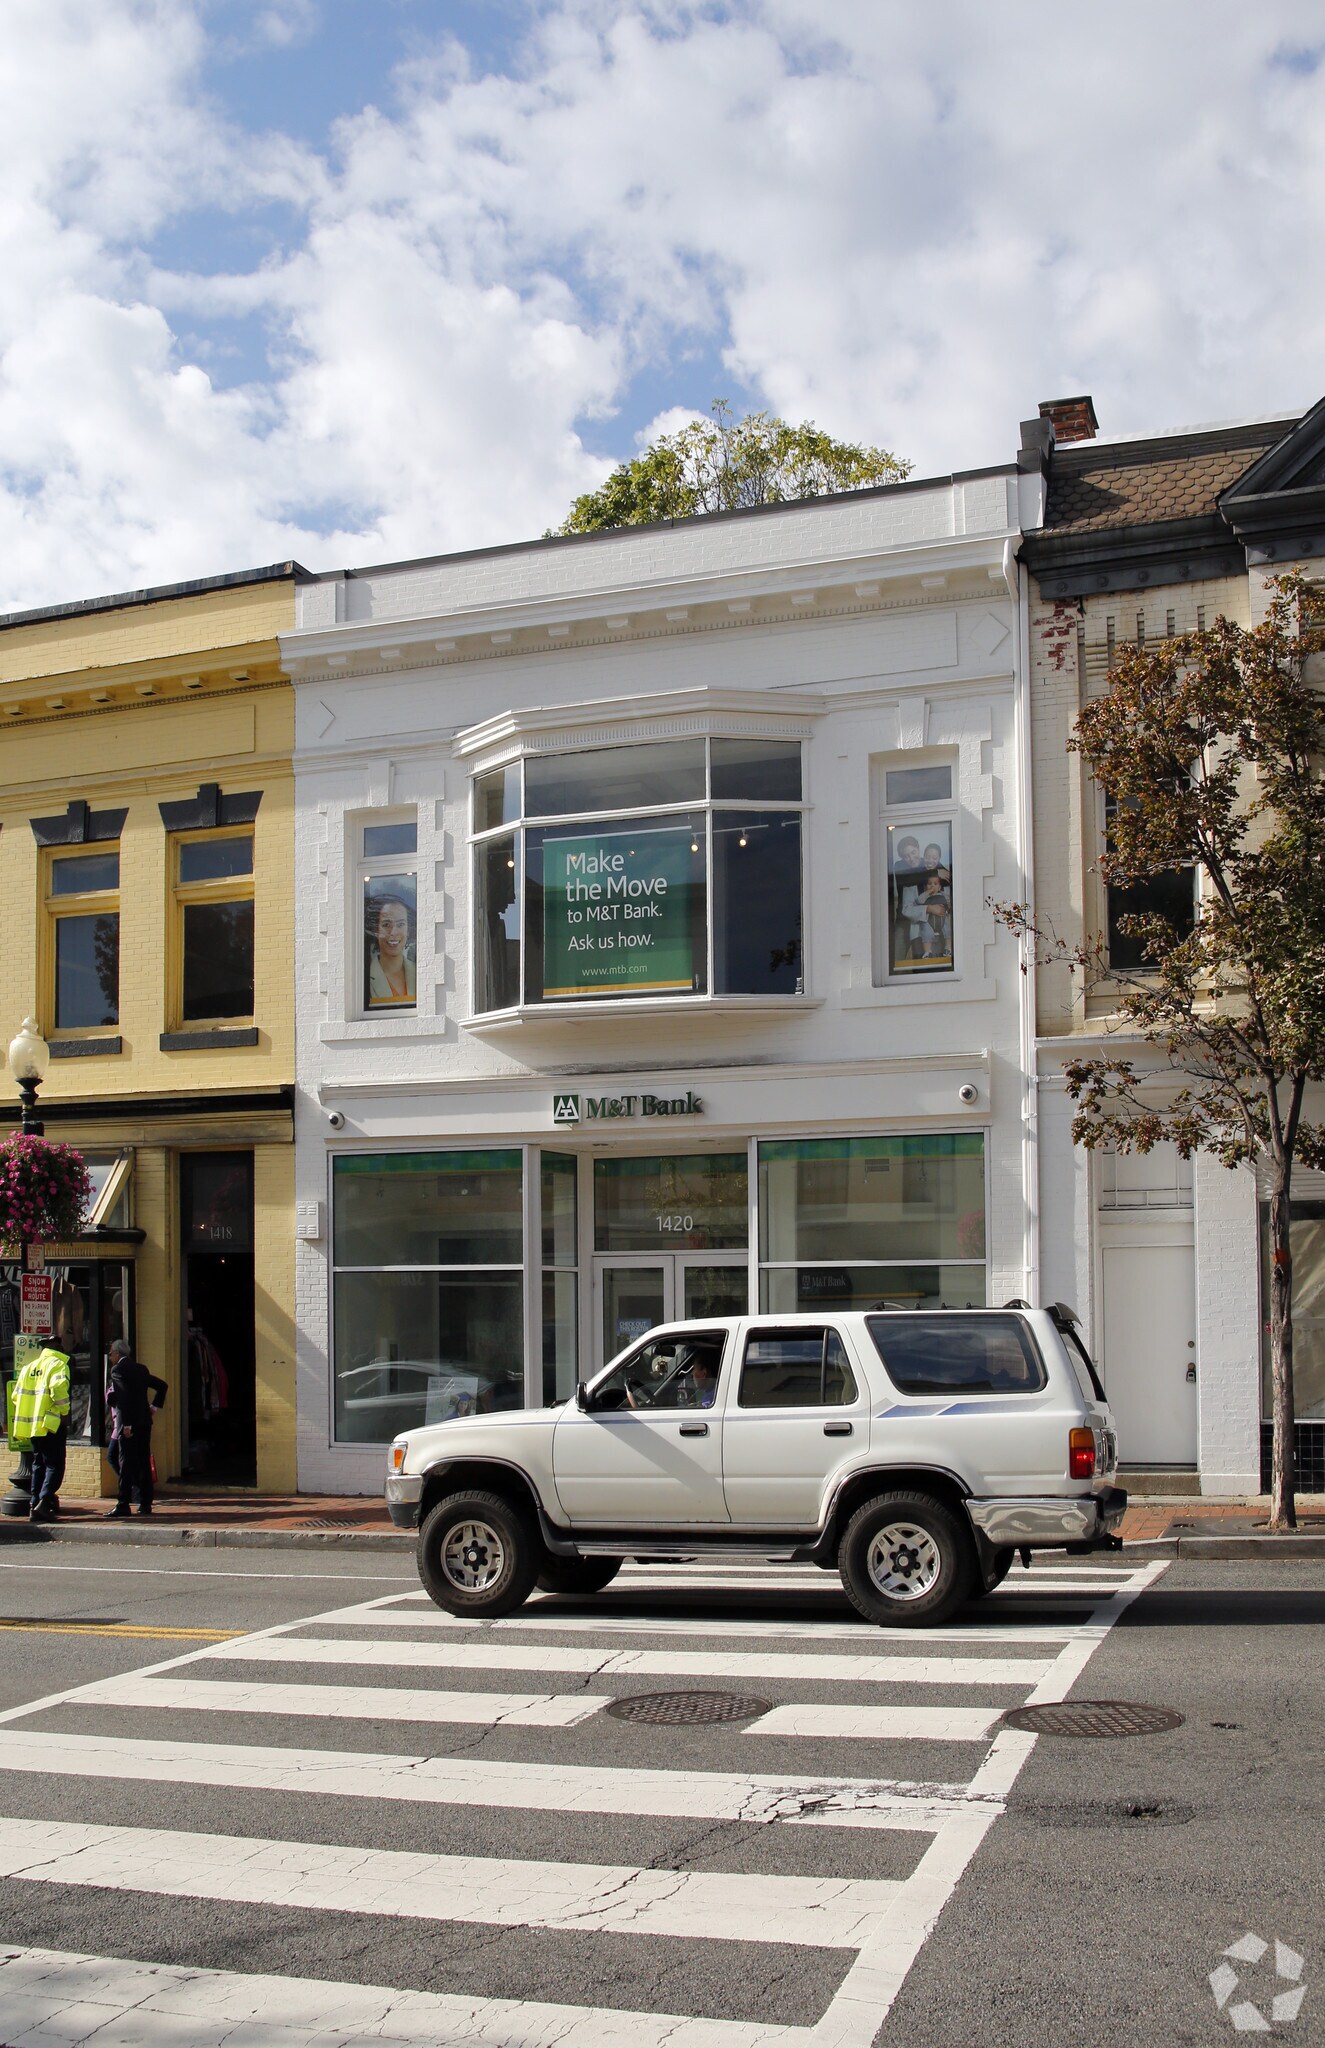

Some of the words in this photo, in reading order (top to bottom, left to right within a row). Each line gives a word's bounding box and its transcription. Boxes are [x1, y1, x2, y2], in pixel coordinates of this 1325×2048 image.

[566, 849, 624, 875] Make
[565, 878, 602, 902] the
[607, 875, 668, 899] Move
[567, 909, 583, 924] to
[586, 904, 620, 922] M&T
[624, 901, 663, 919] Bank.
[568, 934, 595, 951] Ask
[598, 936, 614, 949] us
[618, 932, 655, 948] how.
[581, 965, 648, 977] www.mtb.com
[586, 1095, 638, 1119] M&T
[640, 1091, 704, 1117] Bank
[210, 1225, 233, 1240] 1418
[656, 1215, 694, 1231] 1420
[27, 1277, 47, 1286] SNOW
